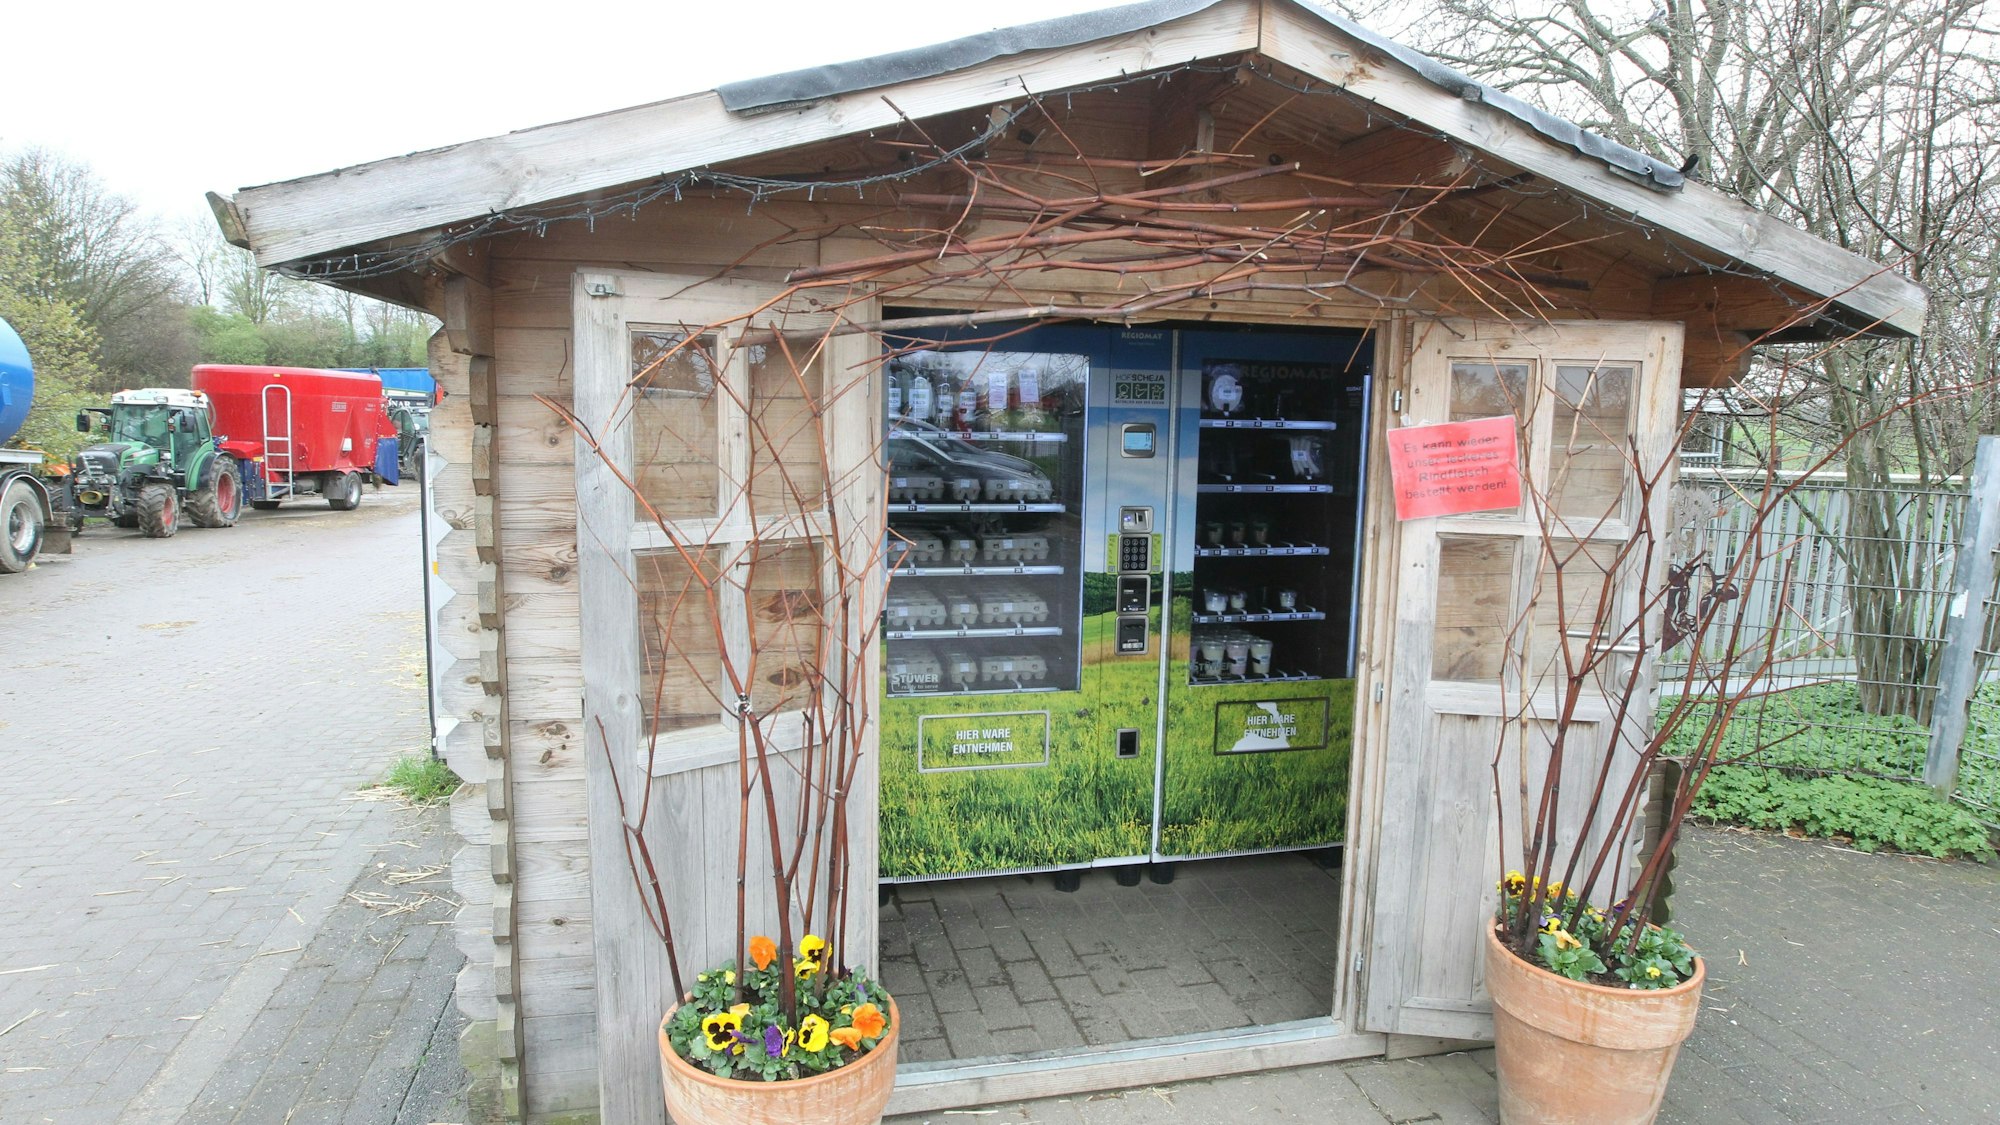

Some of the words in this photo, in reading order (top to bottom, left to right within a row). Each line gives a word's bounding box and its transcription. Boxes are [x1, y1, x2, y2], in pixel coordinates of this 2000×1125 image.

[1121, 331, 1163, 340] REGIOMAT
[1241, 365, 1330, 380] REGIOMAT
[1403, 443, 1418, 453] Es
[1422, 440, 1452, 450] kann
[1457, 435, 1500, 447] wieder
[1407, 457, 1442, 469] unser
[1446, 451, 1499, 464] leckeres
[1418, 466, 1489, 482] Rindfleisch
[1405, 486, 1452, 499] bestellt
[1456, 479, 1507, 494] werden!
[891, 672, 939, 684] STÜWER
[1247, 715, 1268, 726] HIER
[956, 730, 979, 740] HIER
[982, 728, 1011, 739] WARE
[953, 742, 1013, 754] ENTNEHMEN
